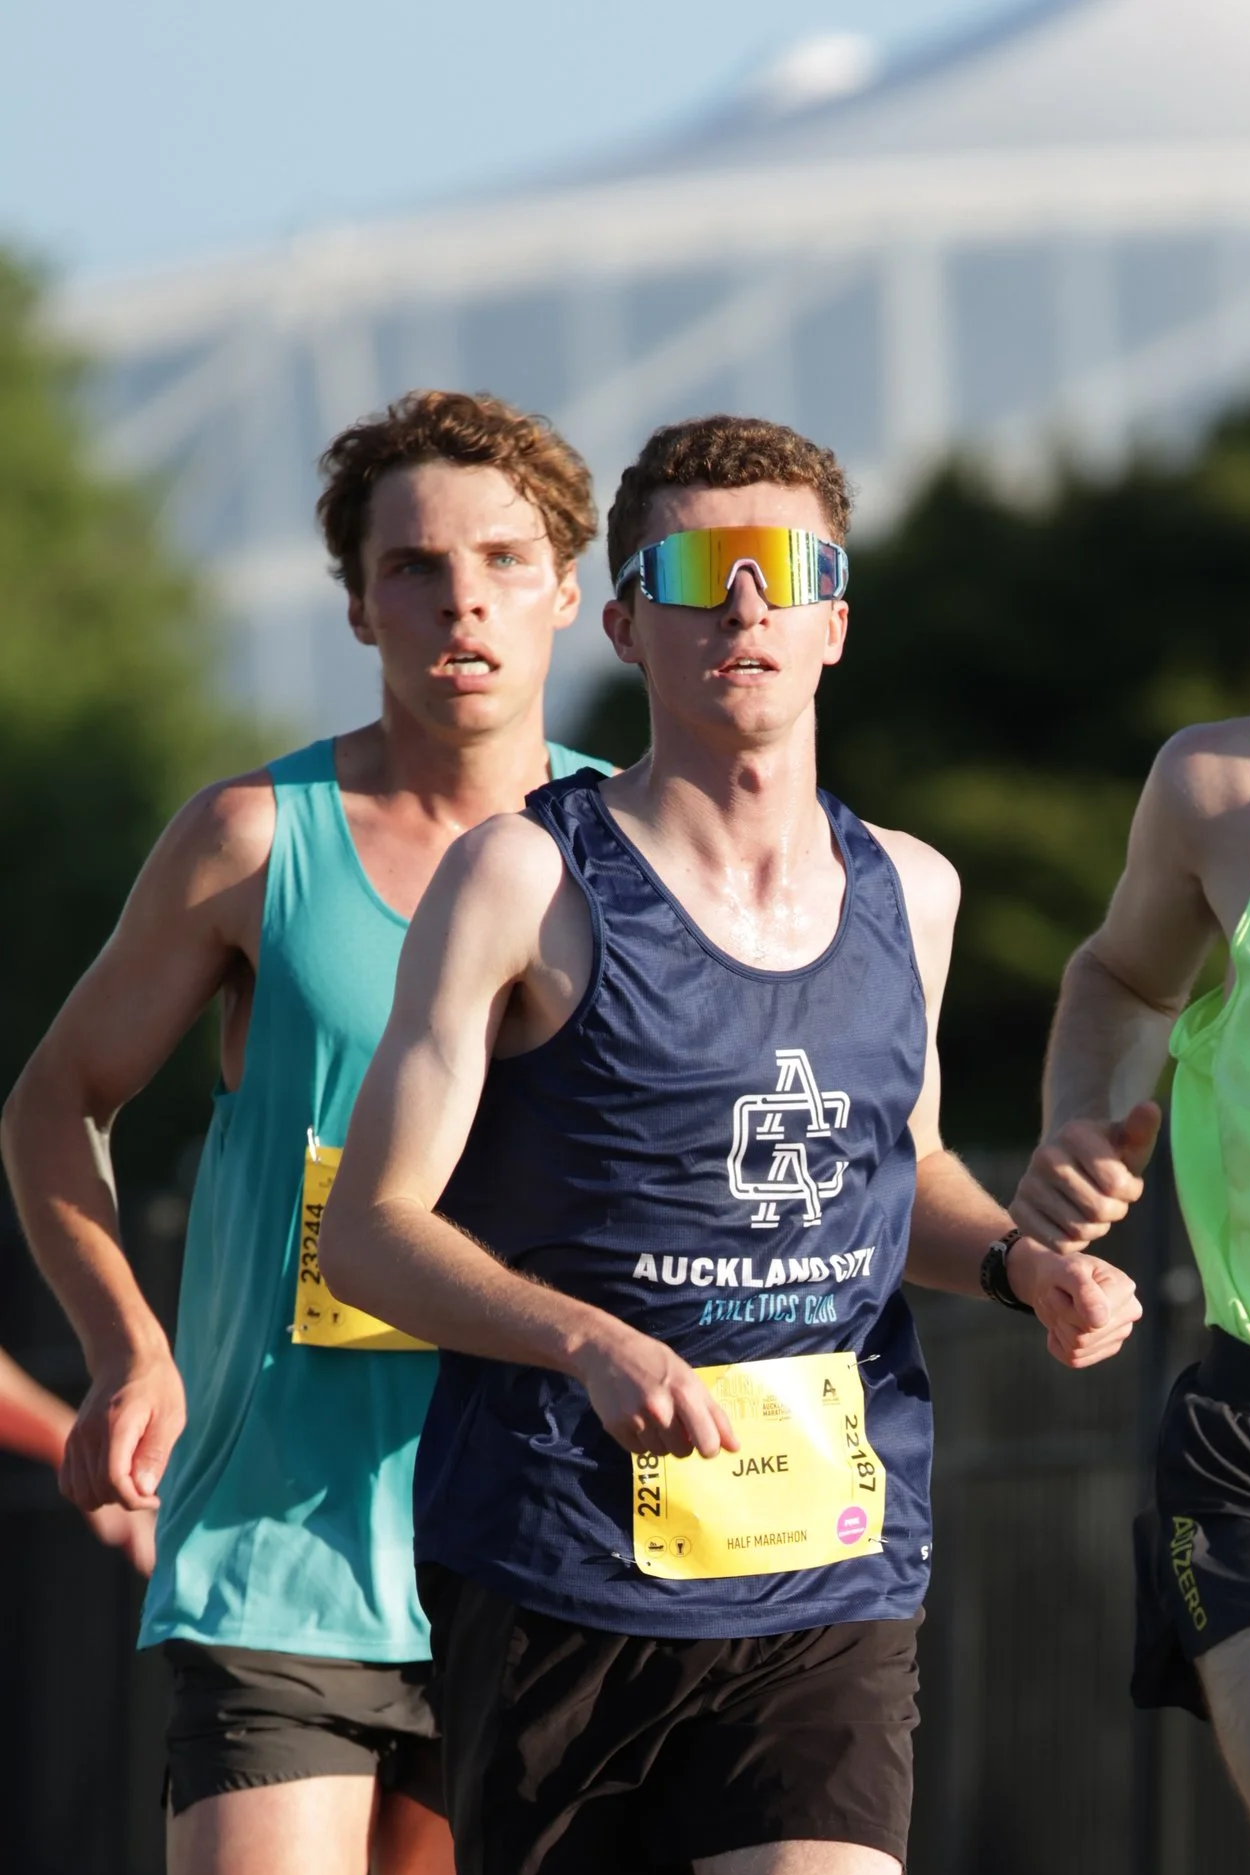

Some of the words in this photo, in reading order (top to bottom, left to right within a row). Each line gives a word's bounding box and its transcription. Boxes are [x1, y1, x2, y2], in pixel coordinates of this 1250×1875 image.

[632, 1252, 829, 1289] AUCKLAND
[829, 1246, 876, 1284] CITY
[698, 1294, 800, 1326] ATHLETICS
[804, 1293, 838, 1326] CLUB
[732, 1454, 789, 1478] JAKE
[845, 1414, 877, 1493] 22187
[637, 1451, 661, 1517] 2218
[727, 1534, 751, 1550] HALF
[754, 1529, 807, 1547] MARATHON
